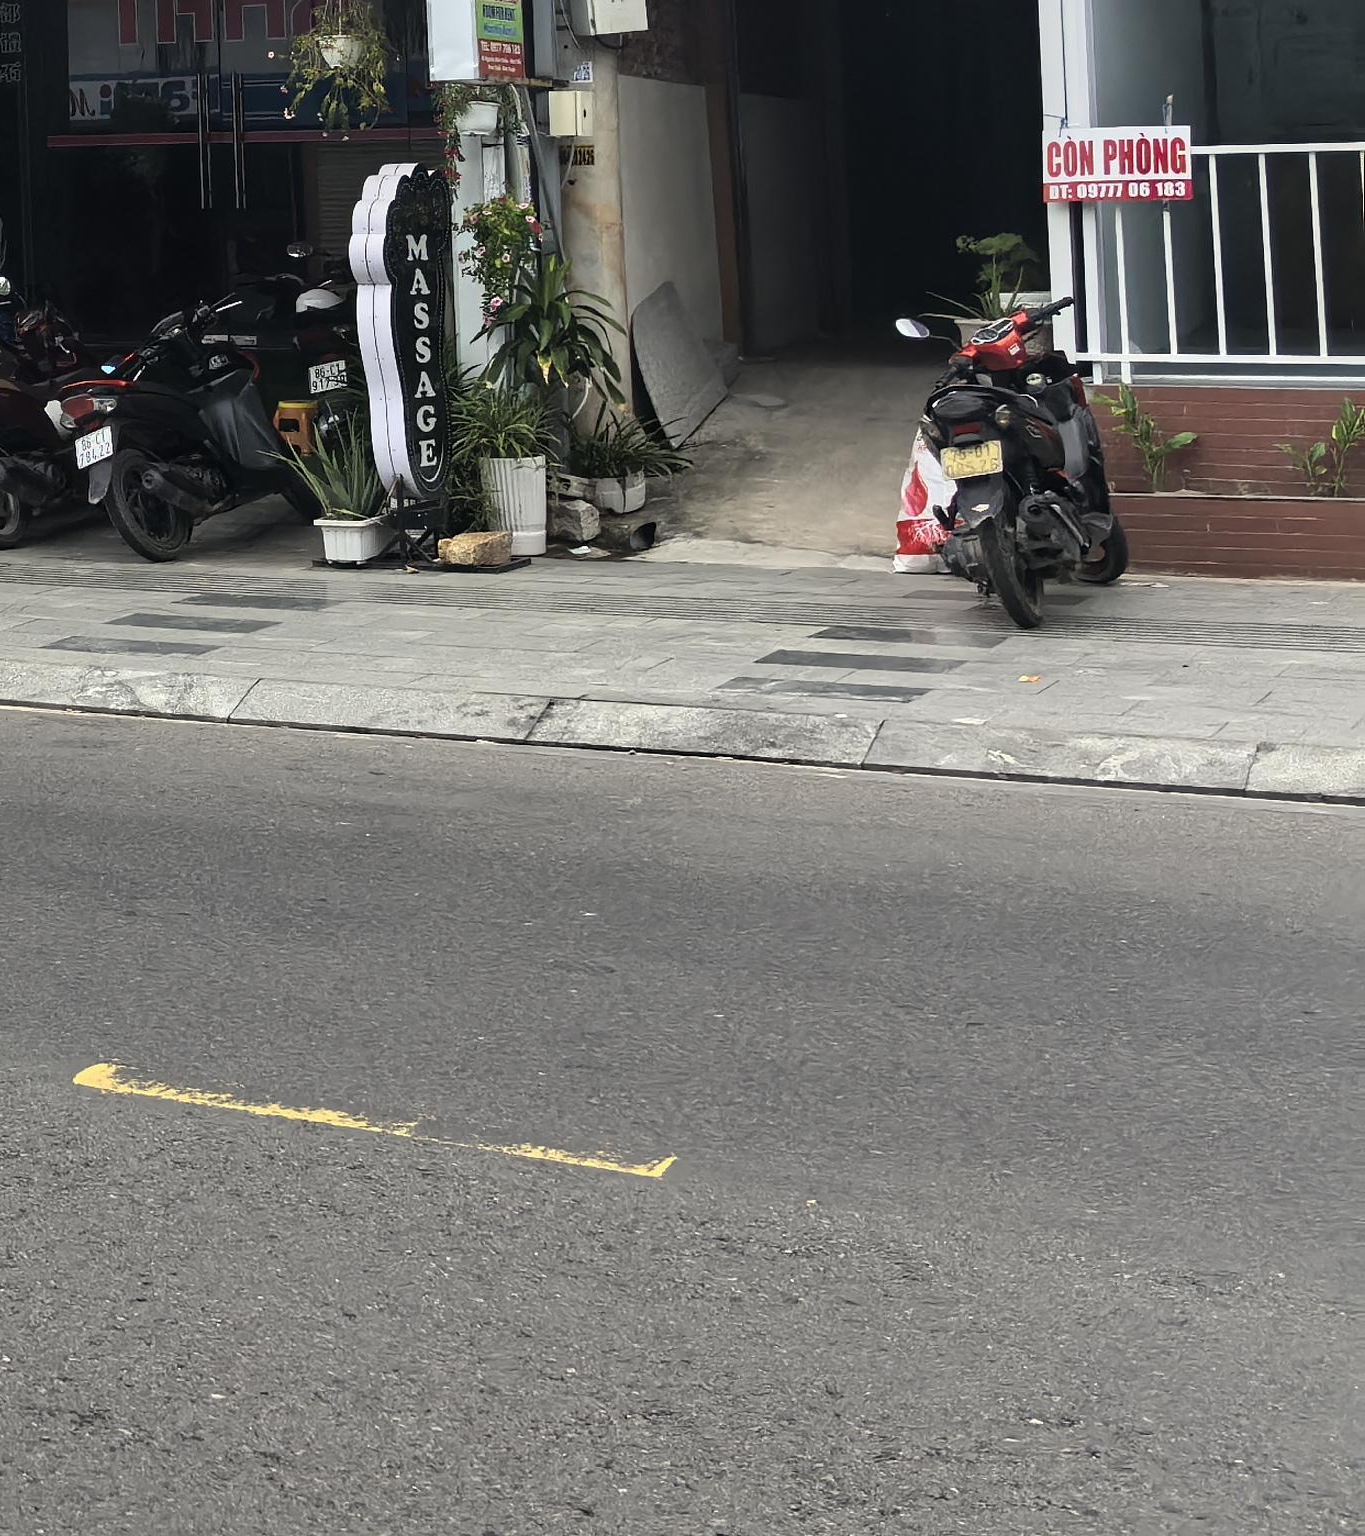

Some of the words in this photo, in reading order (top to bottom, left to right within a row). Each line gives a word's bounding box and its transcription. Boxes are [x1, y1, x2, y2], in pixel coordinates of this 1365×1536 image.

[1047, 136, 1094, 178] CÒN
[1103, 132, 1186, 175] PHÒNG
[1077, 183, 1123, 198] 09777
[1129, 182, 1150, 197] 06
[1156, 181, 1185, 196] 183
[405, 234, 437, 467] MASSAGE
